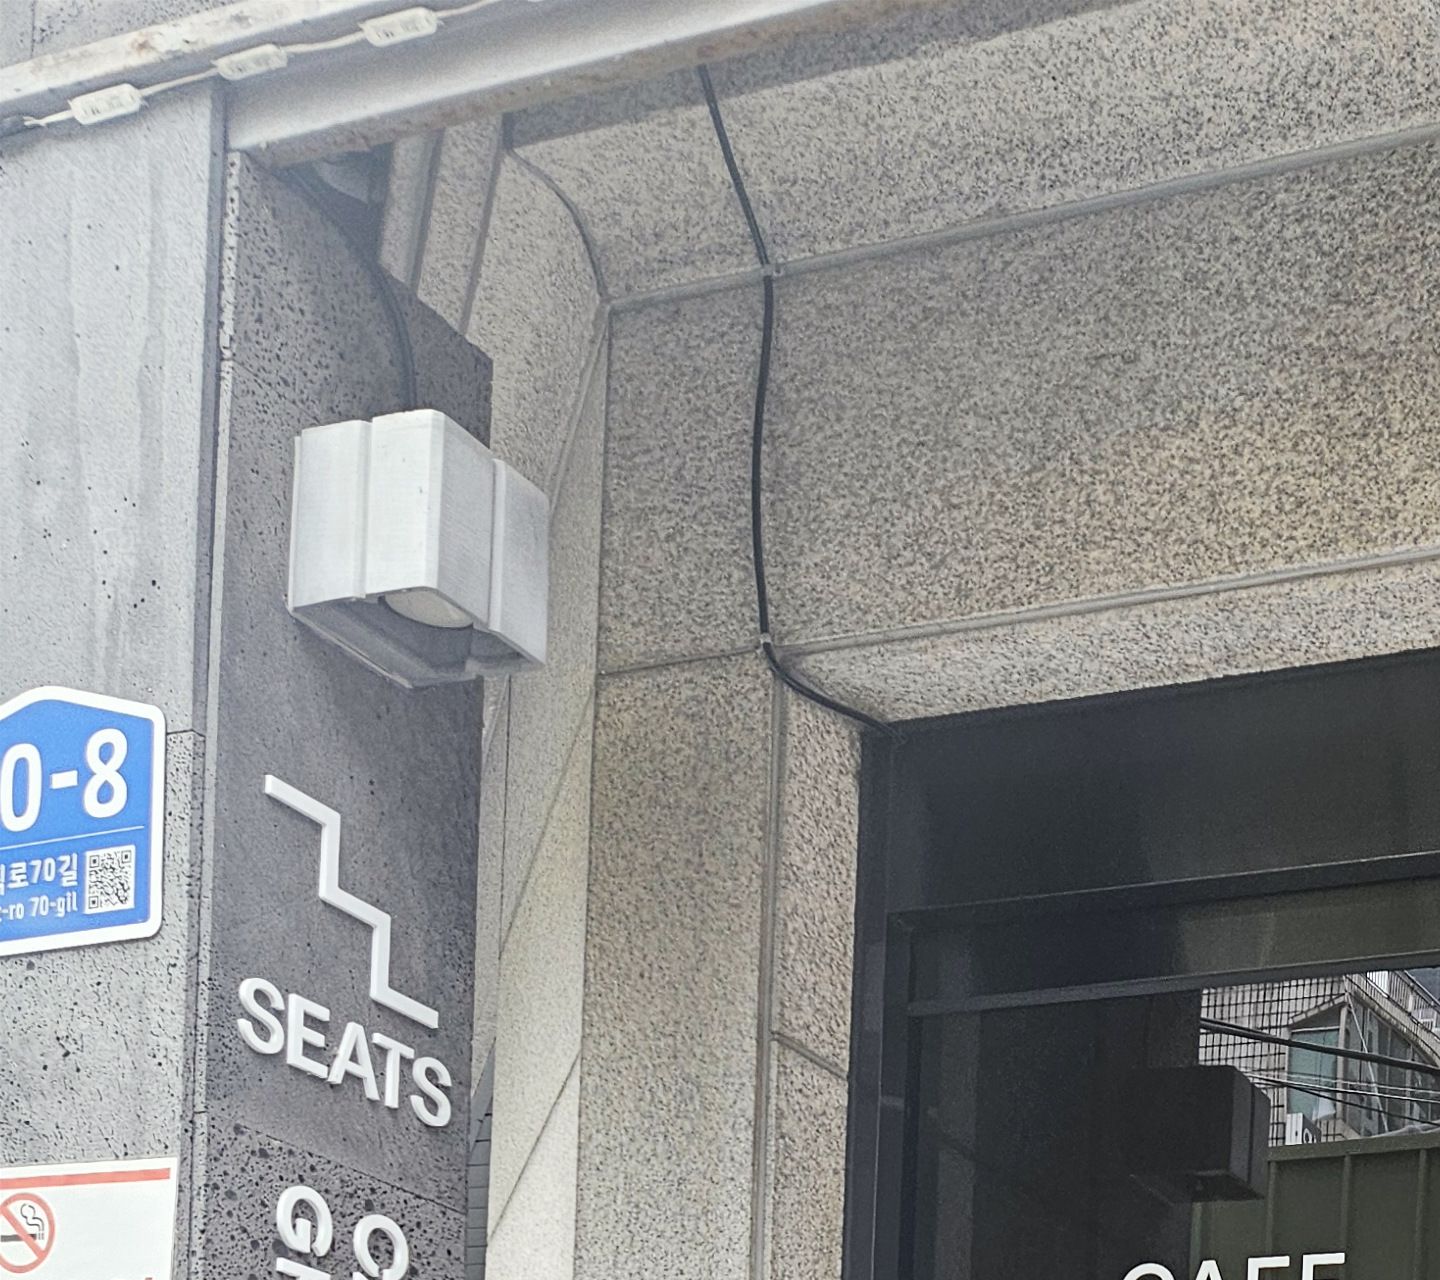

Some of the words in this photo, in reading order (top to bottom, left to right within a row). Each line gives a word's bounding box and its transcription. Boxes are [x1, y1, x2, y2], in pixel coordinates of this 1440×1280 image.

[0, 728, 128, 832] 0-8
[0, 902, 25, 922] -ro
[29, 891, 78, 918] 70-gil
[237, 978, 452, 1127] SEATS
